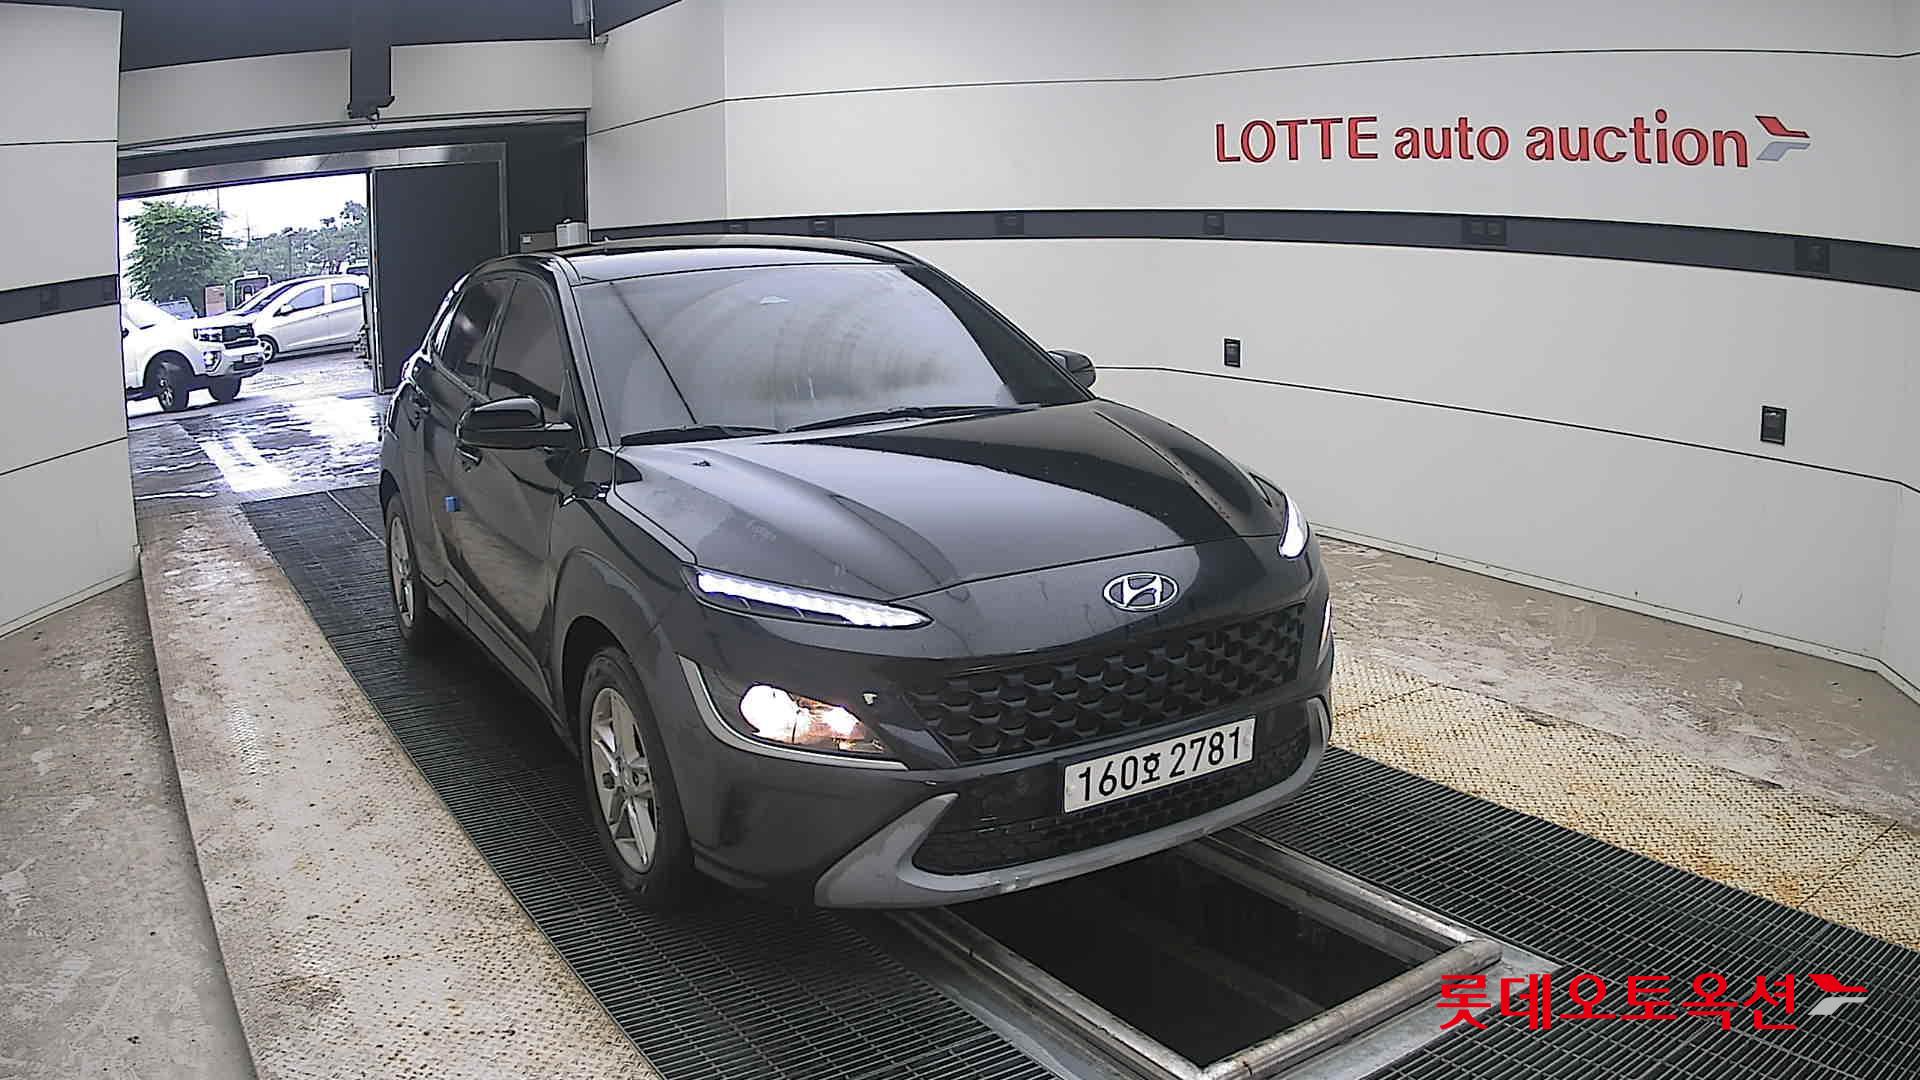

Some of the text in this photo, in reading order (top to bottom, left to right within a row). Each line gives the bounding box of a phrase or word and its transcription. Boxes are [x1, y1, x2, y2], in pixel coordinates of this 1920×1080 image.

[1216, 109, 1749, 168] LOTTE auto auction
[1169, 726, 1240, 778] 2781
